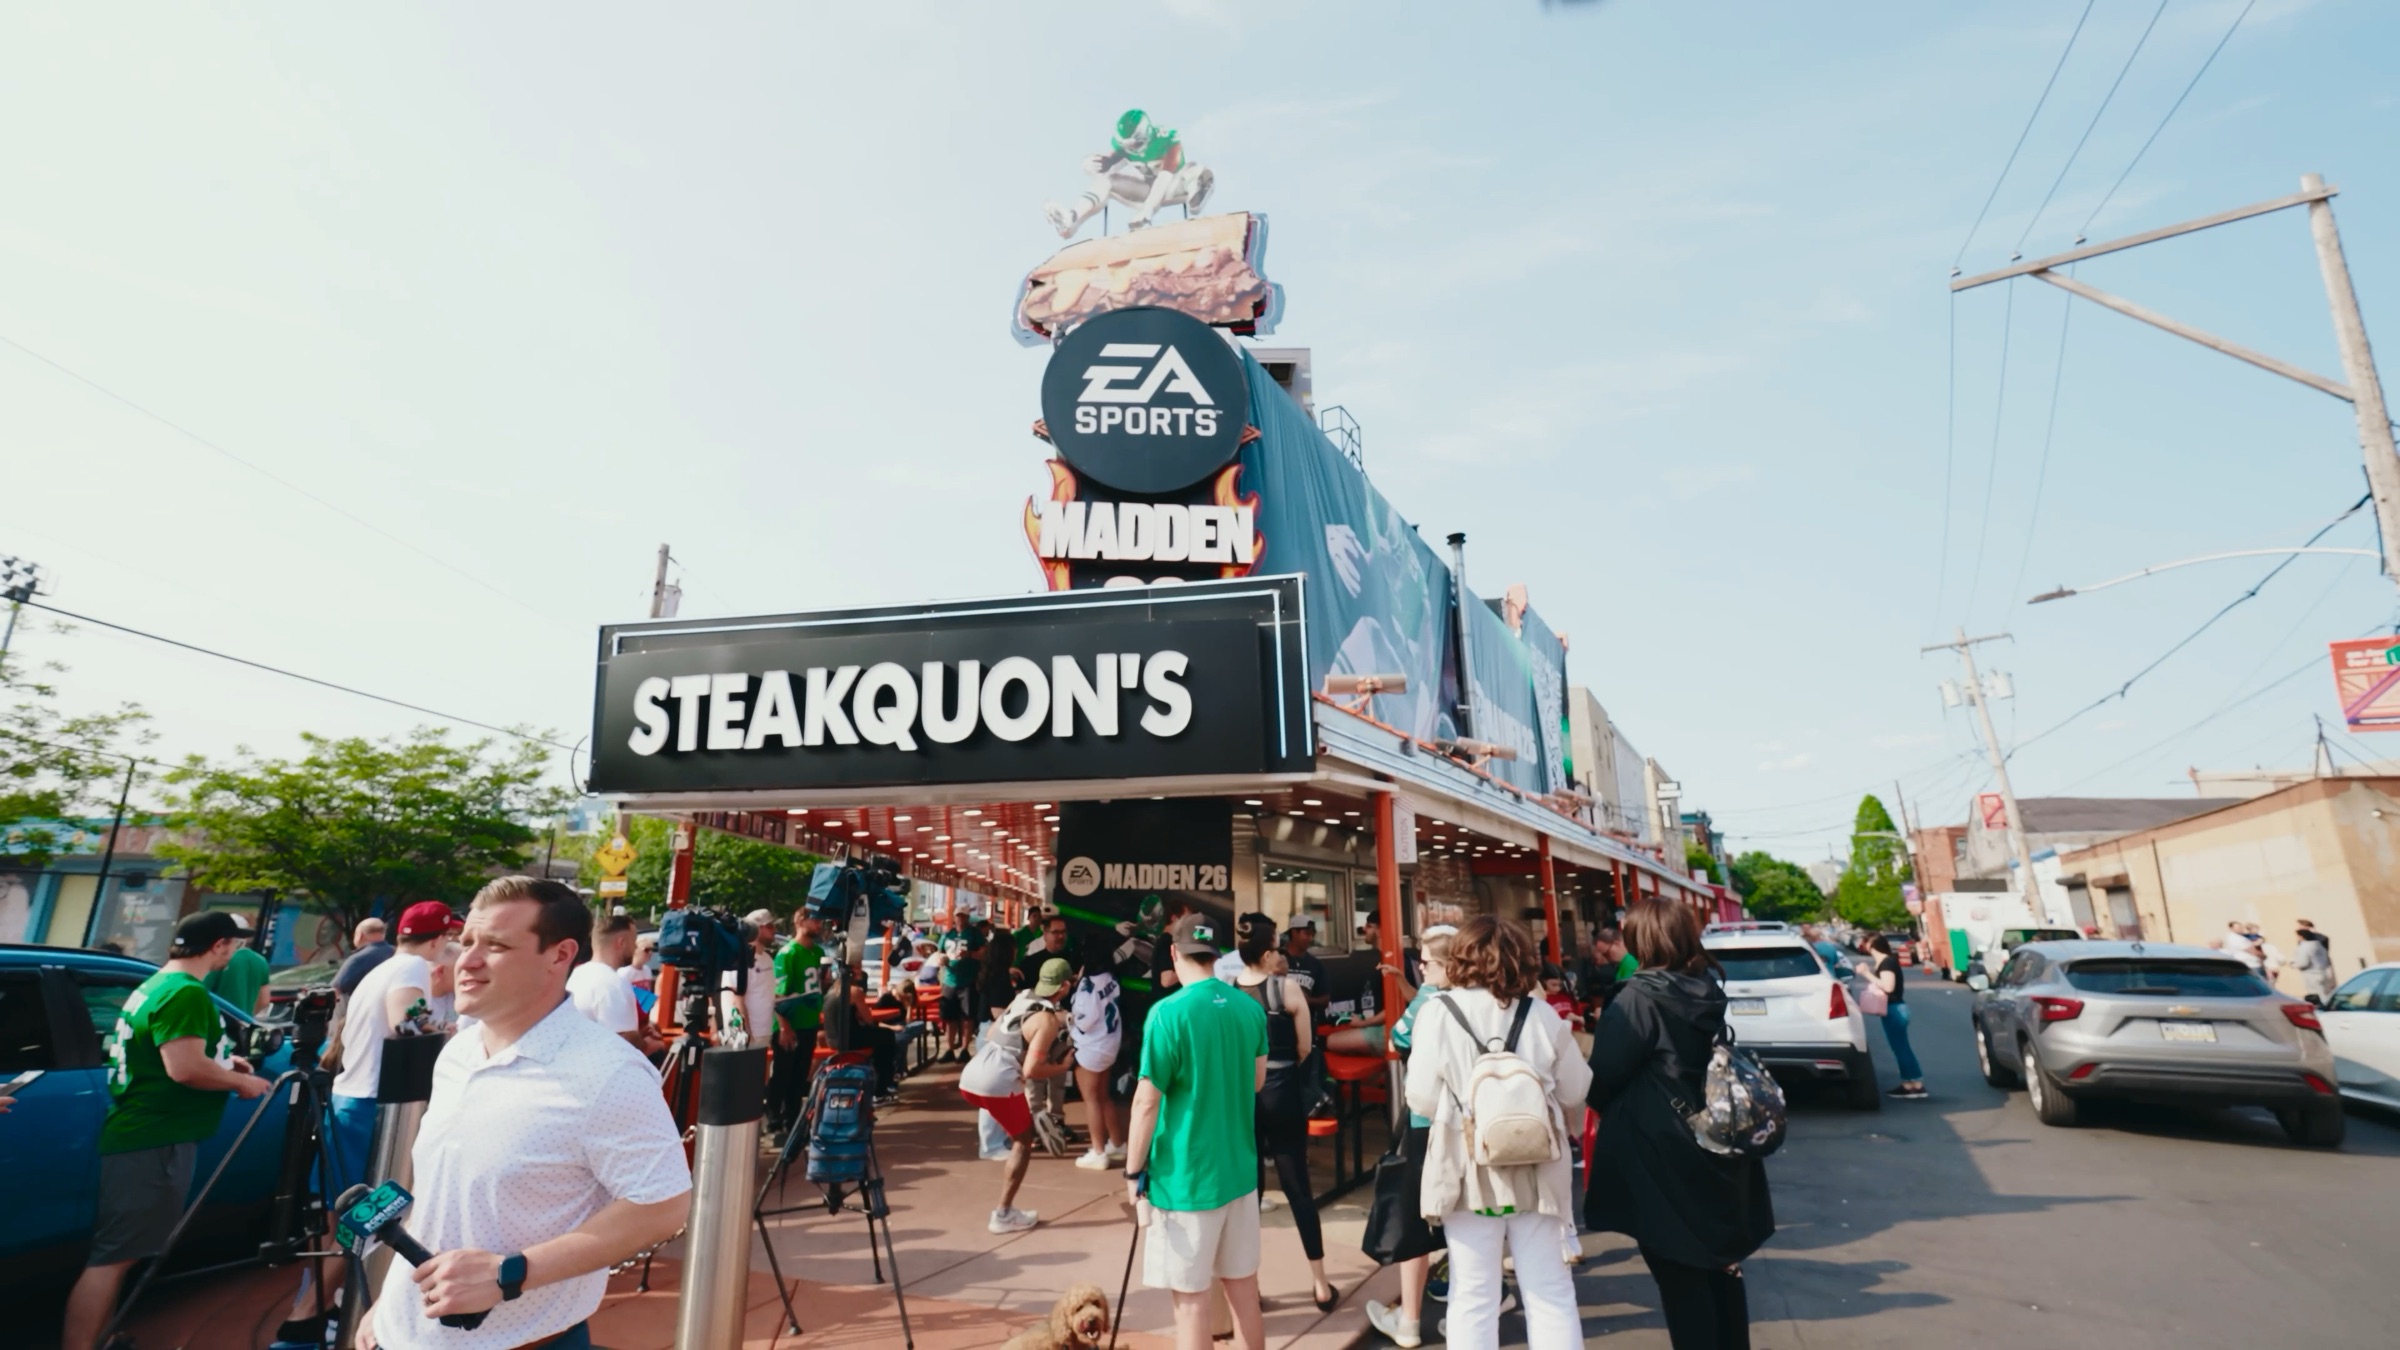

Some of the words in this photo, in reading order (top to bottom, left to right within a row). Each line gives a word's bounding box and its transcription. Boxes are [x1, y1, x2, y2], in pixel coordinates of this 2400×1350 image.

[1077, 343, 1215, 405] EA
[1039, 500, 1254, 564] MADDEN
[627, 650, 1192, 756] STEAKQUON'S
[1400, 818, 1410, 860] CAUTION
[1068, 878, 1094, 886] SPORTS
[1069, 865, 1093, 878] EA
[1104, 863, 1195, 891] MADDEN
[1198, 865, 1228, 891] 26
[369, 1185, 398, 1208] 3
